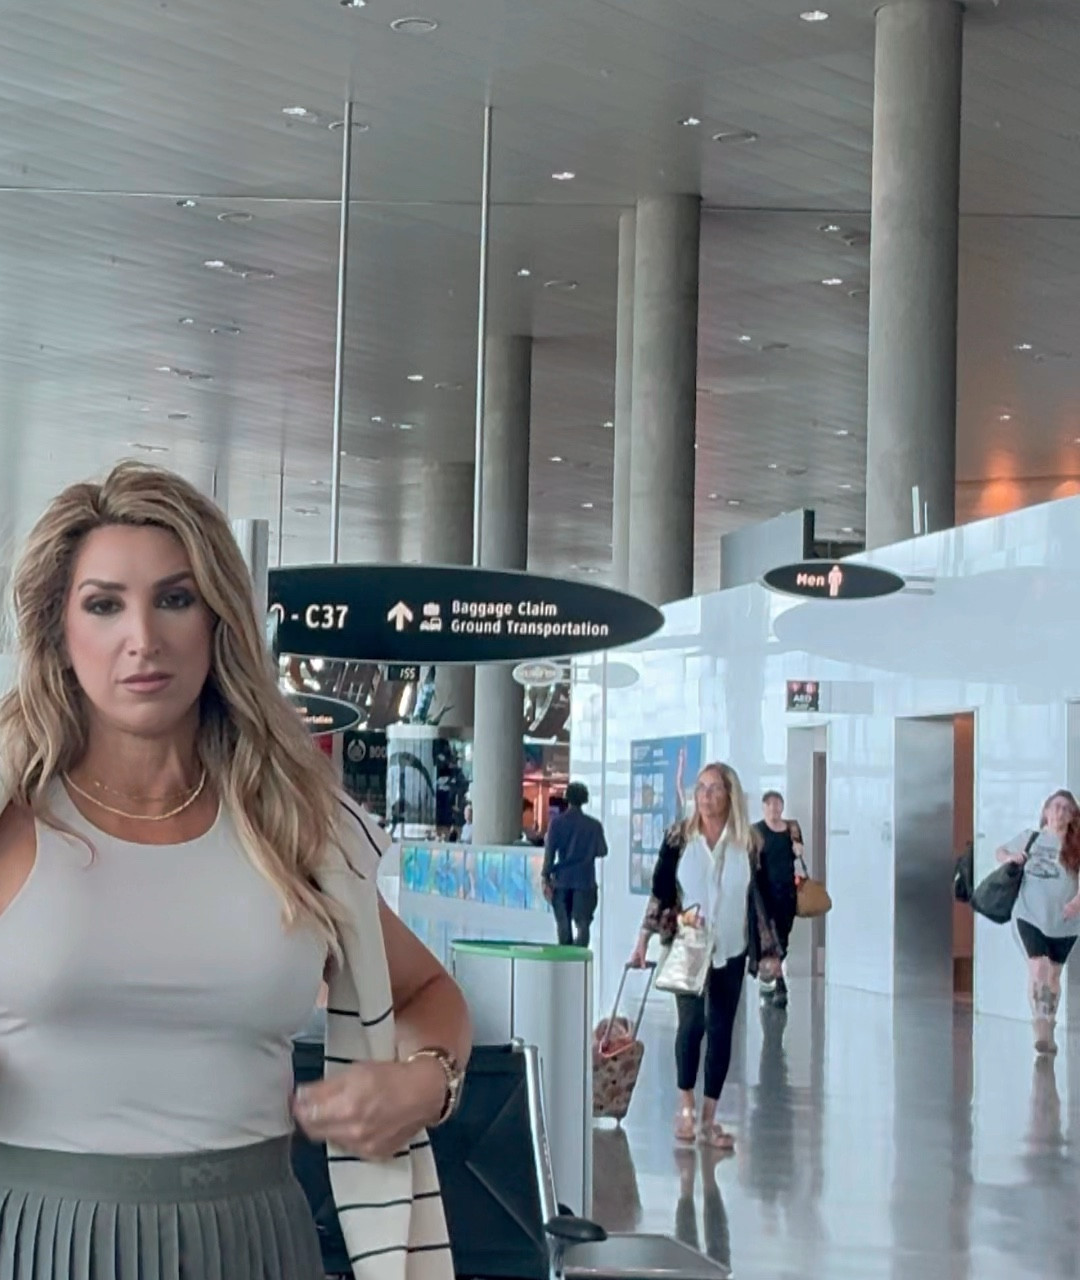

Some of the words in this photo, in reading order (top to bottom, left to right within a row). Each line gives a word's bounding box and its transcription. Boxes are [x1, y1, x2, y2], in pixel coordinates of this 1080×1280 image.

[796, 573, 825, 587] Men
[305, 603, 349, 629] C37
[451, 599, 513, 618] Baggage
[518, 600, 558, 617] Claim
[450, 618, 502, 634] Ground
[506, 619, 609, 638] Transportation
